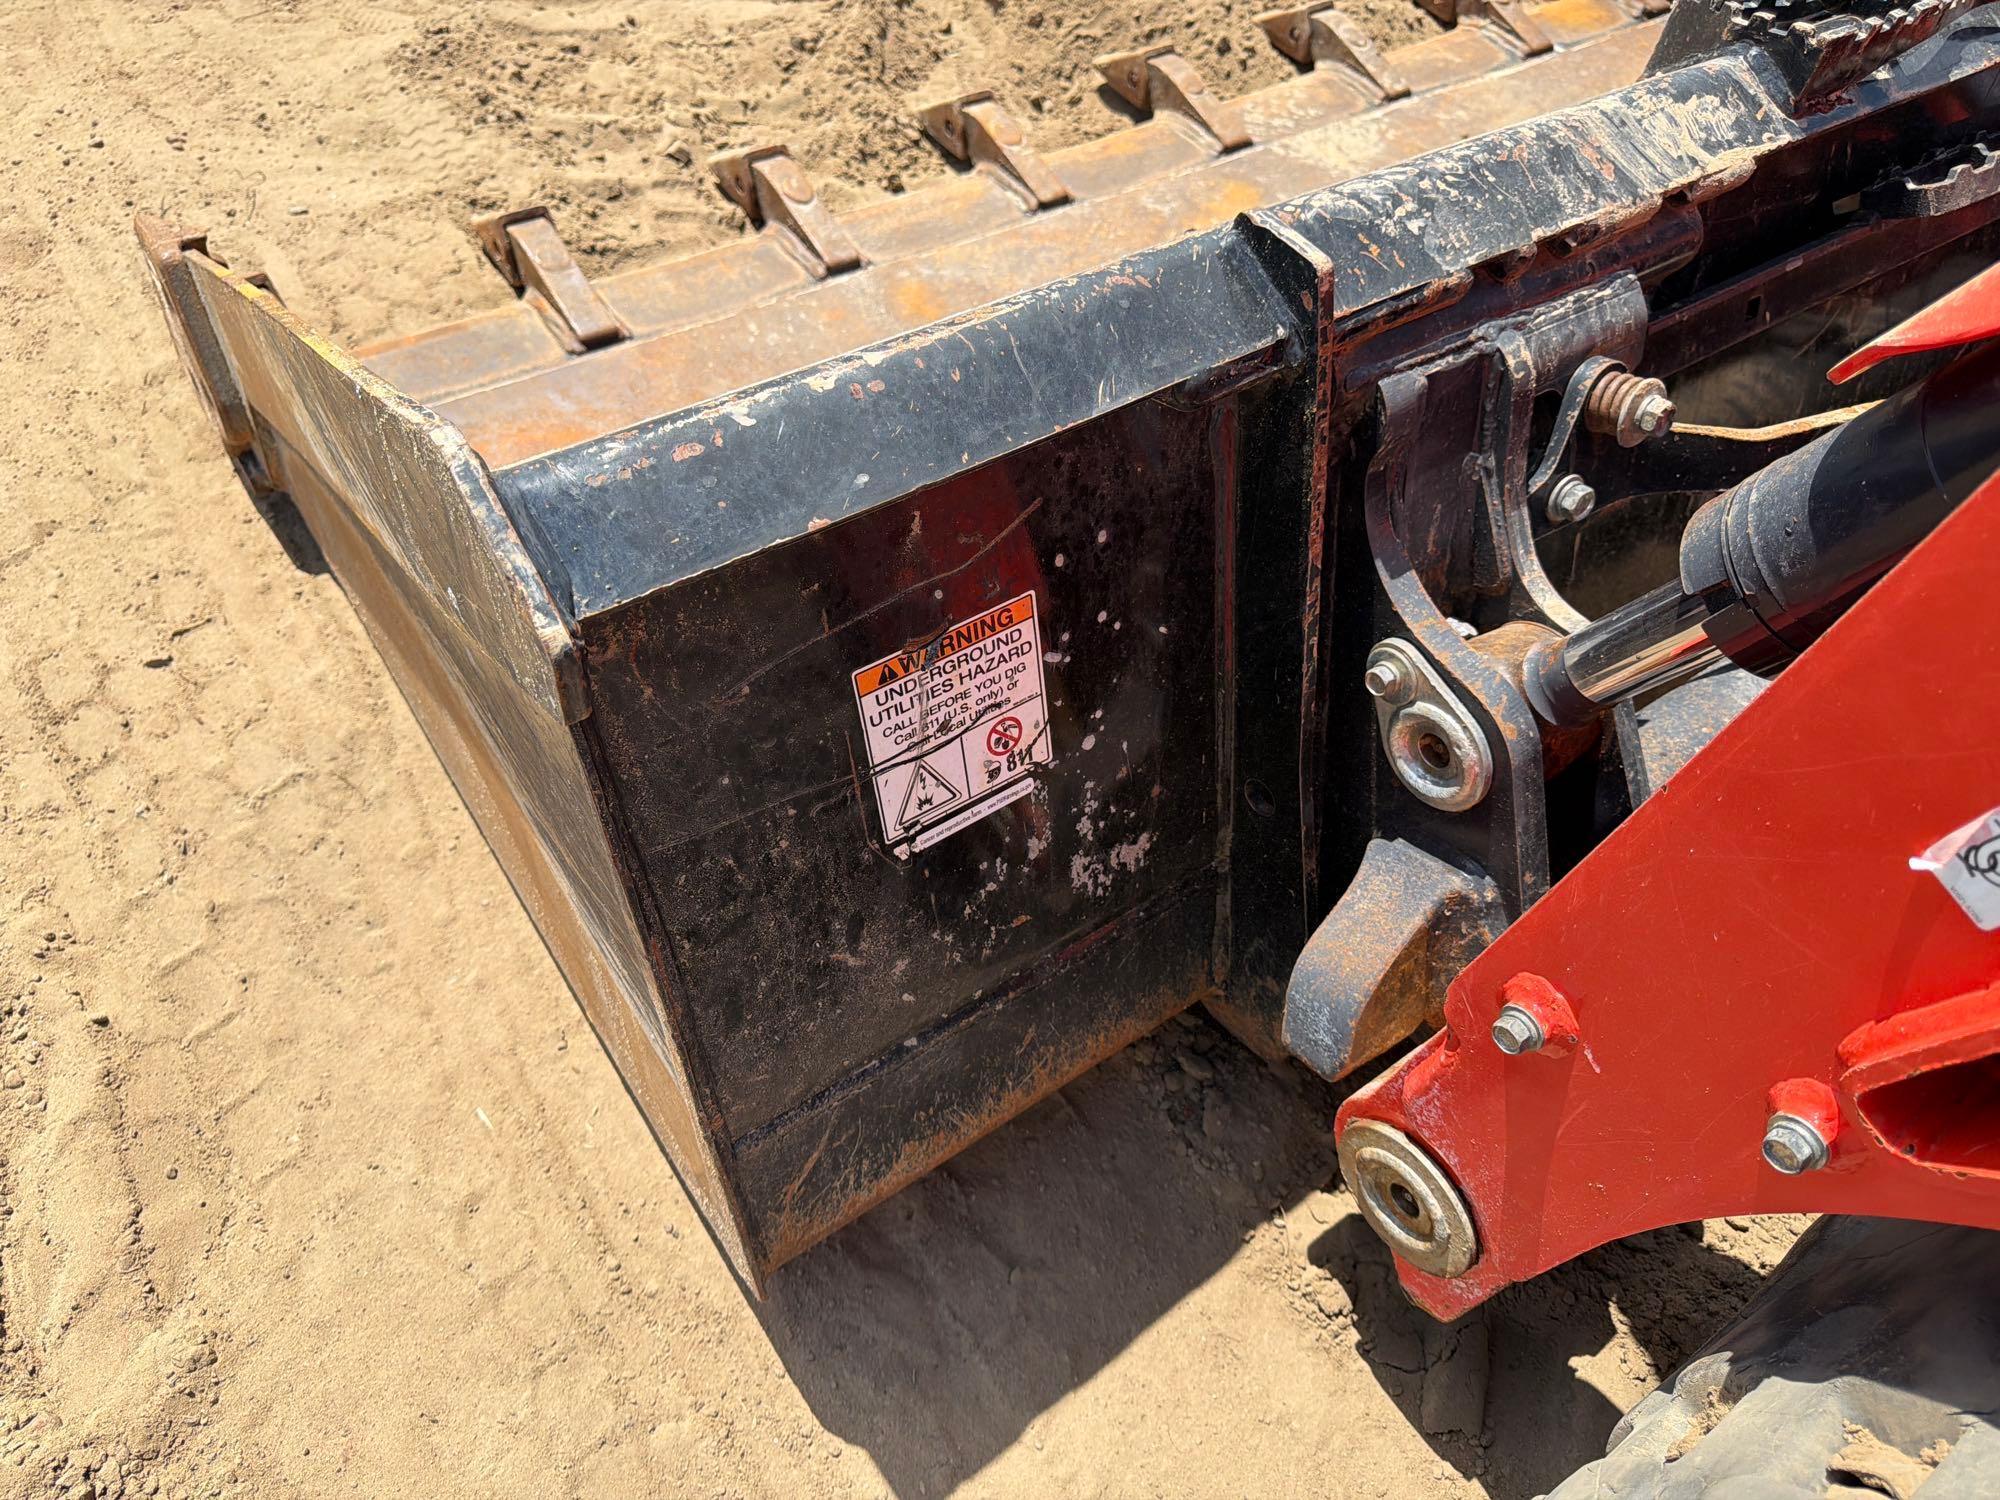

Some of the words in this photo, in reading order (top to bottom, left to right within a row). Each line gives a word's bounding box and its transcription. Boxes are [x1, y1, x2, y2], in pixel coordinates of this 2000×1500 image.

[875, 628, 1022, 706] UNDERGROUND
[898, 608, 1013, 673] WRNING
[869, 679, 954, 727] UTILITIES
[958, 641, 1032, 685] HAZARD
[883, 717, 917, 738] CALL
[921, 688, 972, 720] BEFORE
[975, 673, 1002, 692] YOU
[1005, 662, 1026, 679] DIG
[894, 727, 917, 745] Call
[922, 717, 940, 732] 811
[976, 686, 1004, 706] only)
[1007, 679, 1019, 691] or
